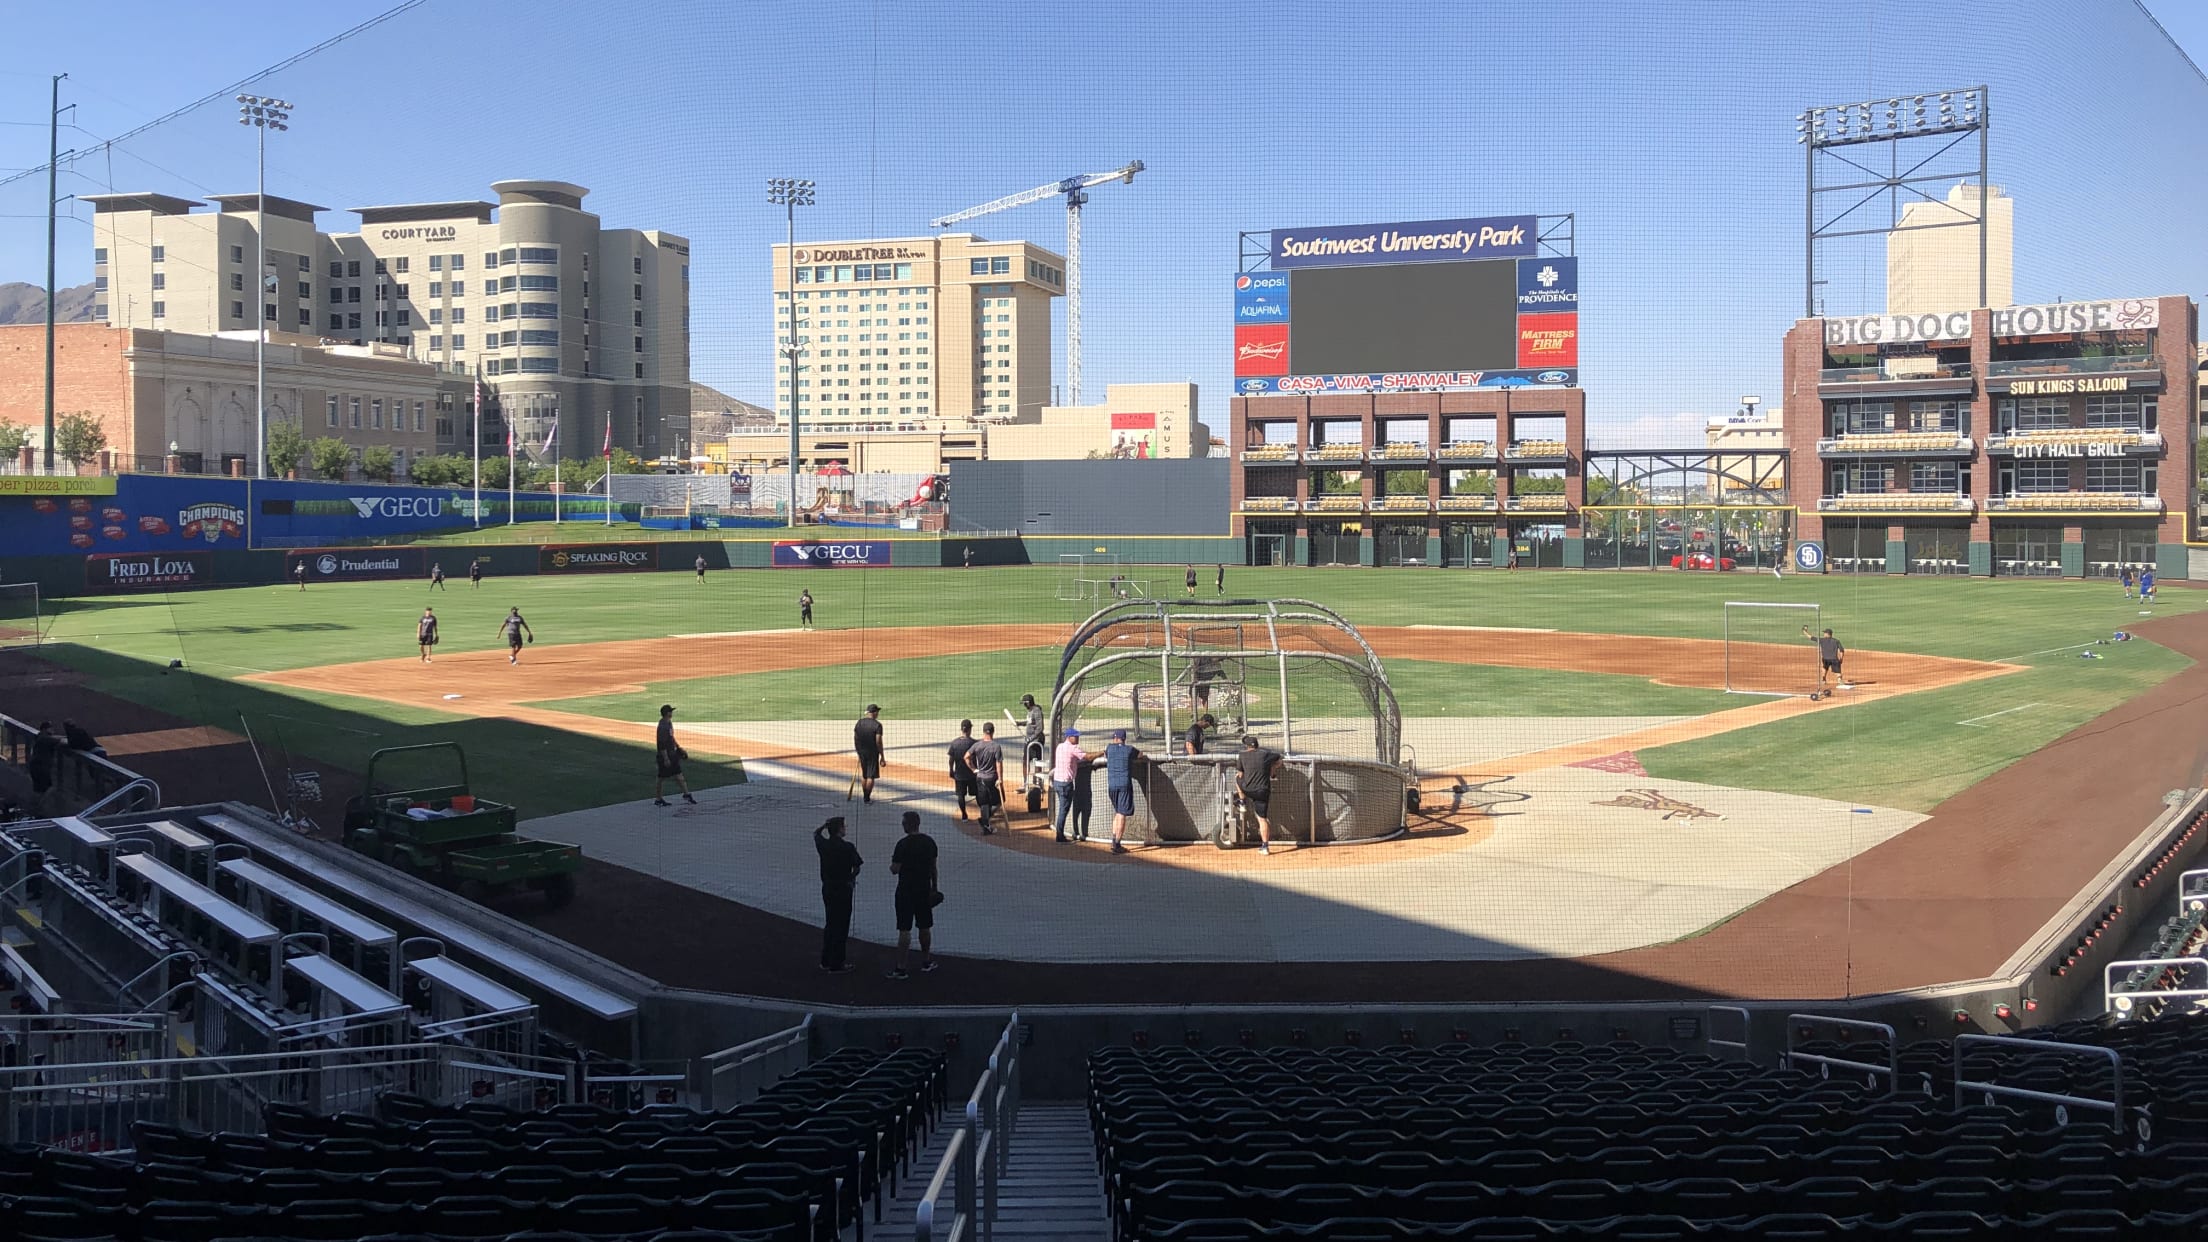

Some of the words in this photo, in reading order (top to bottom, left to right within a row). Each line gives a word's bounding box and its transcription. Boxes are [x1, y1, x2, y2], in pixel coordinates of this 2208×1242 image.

[382, 226, 456, 240] COURTYARD
[1281, 236, 1376, 257] Southwest
[1381, 231, 1475, 253] University
[1479, 224, 1525, 247] Park
[1254, 277, 1286, 289] pepsi
[1519, 293, 1578, 304] PROVIDENCE
[1241, 304, 1282, 317] AQUAFINA
[1993, 303, 2111, 335] HOUSE
[1521, 330, 1575, 339] MATTRESS
[1826, 317, 1882, 345] BIG
[1892, 312, 1969, 341] DOG
[1533, 339, 1563, 349] FIRM
[2010, 381, 2035, 395] SUN
[2038, 379, 2075, 394] KINGS
[2078, 377, 2128, 392] SALOON
[2014, 444, 2044, 458] CITY
[2048, 442, 2083, 457] HALL
[2088, 442, 2127, 457] GRILL
[24, 478, 60, 493] pizza
[64, 479, 96, 493] porch
[380, 497, 441, 517] GECU
[179, 506, 244, 526] CHAMPIONS
[570, 553, 618, 563] SPEAKING
[619, 551, 648, 565] ROCK
[815, 545, 869, 559] GECU
[109, 559, 149, 577] FRED
[153, 557, 195, 575] LOYA
[341, 559, 400, 570] Prudential
[114, 575, 189, 584] INSURANCE
